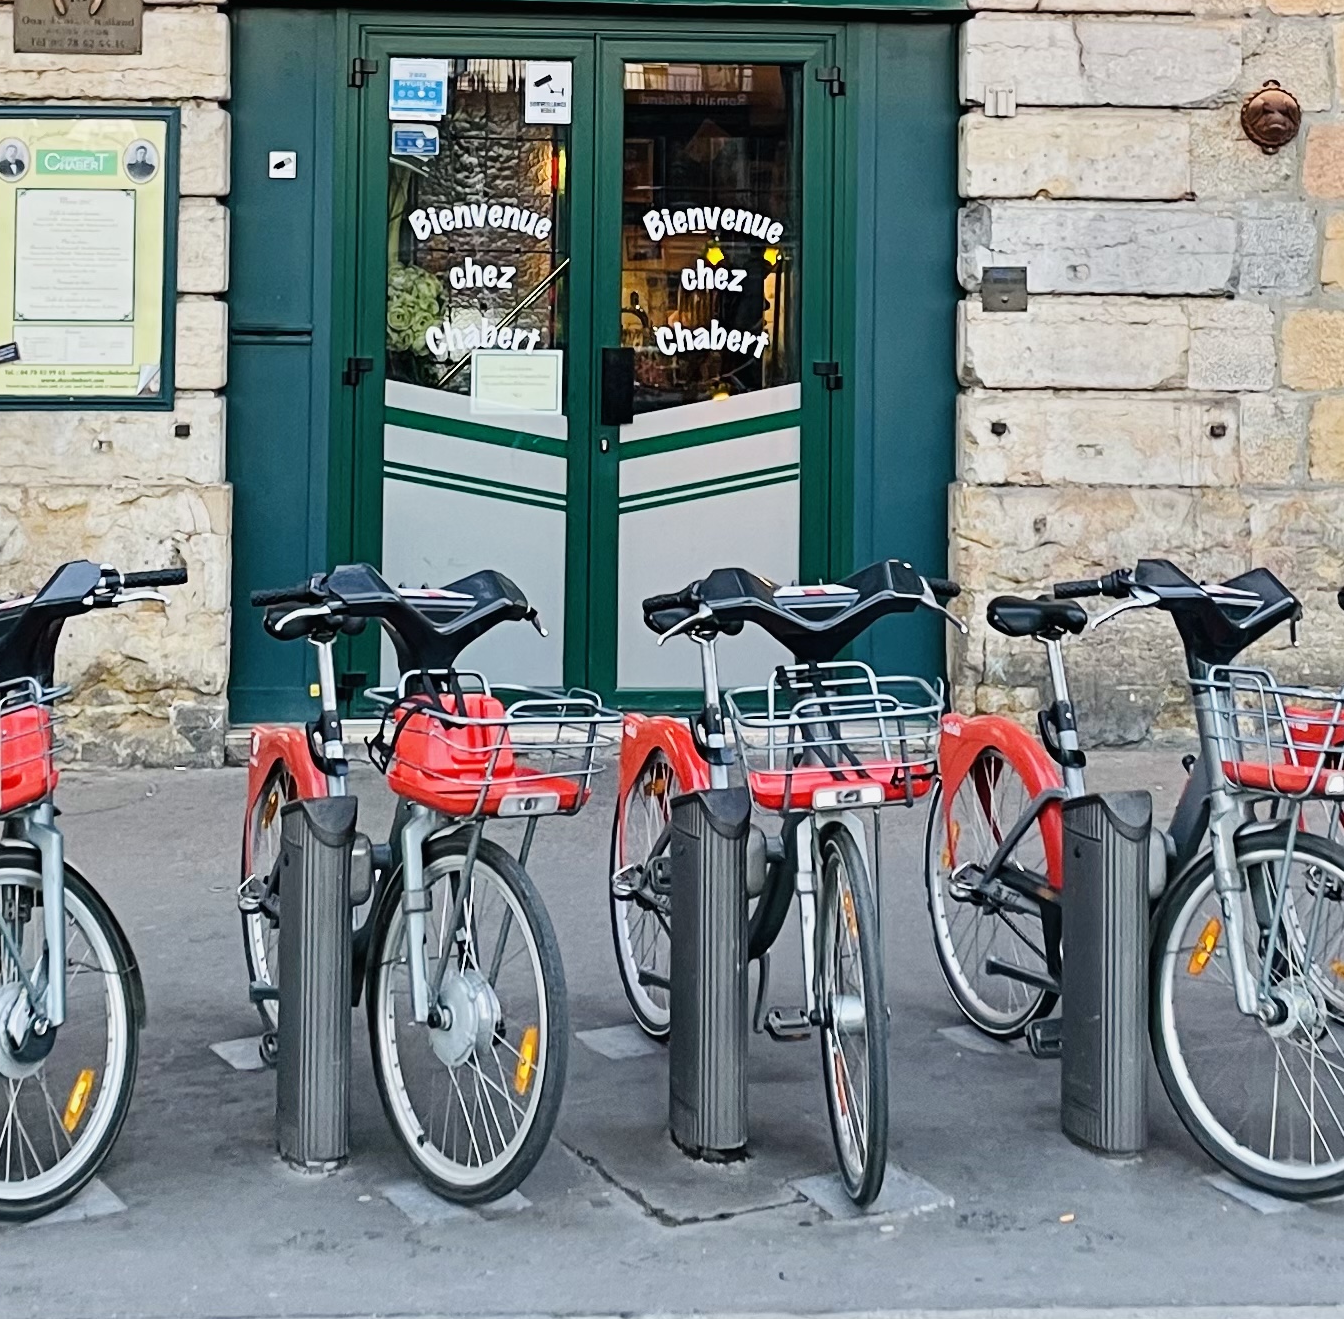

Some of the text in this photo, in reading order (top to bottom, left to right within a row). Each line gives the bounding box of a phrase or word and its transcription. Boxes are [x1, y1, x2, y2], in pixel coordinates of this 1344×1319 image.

[408, 203, 553, 241] Bienvenue
[642, 206, 784, 244] Bienvenue
[449, 256, 517, 290] chez
[680, 258, 748, 293] chez
[425, 317, 541, 357] Chabert
[655, 319, 770, 359] Chabert
